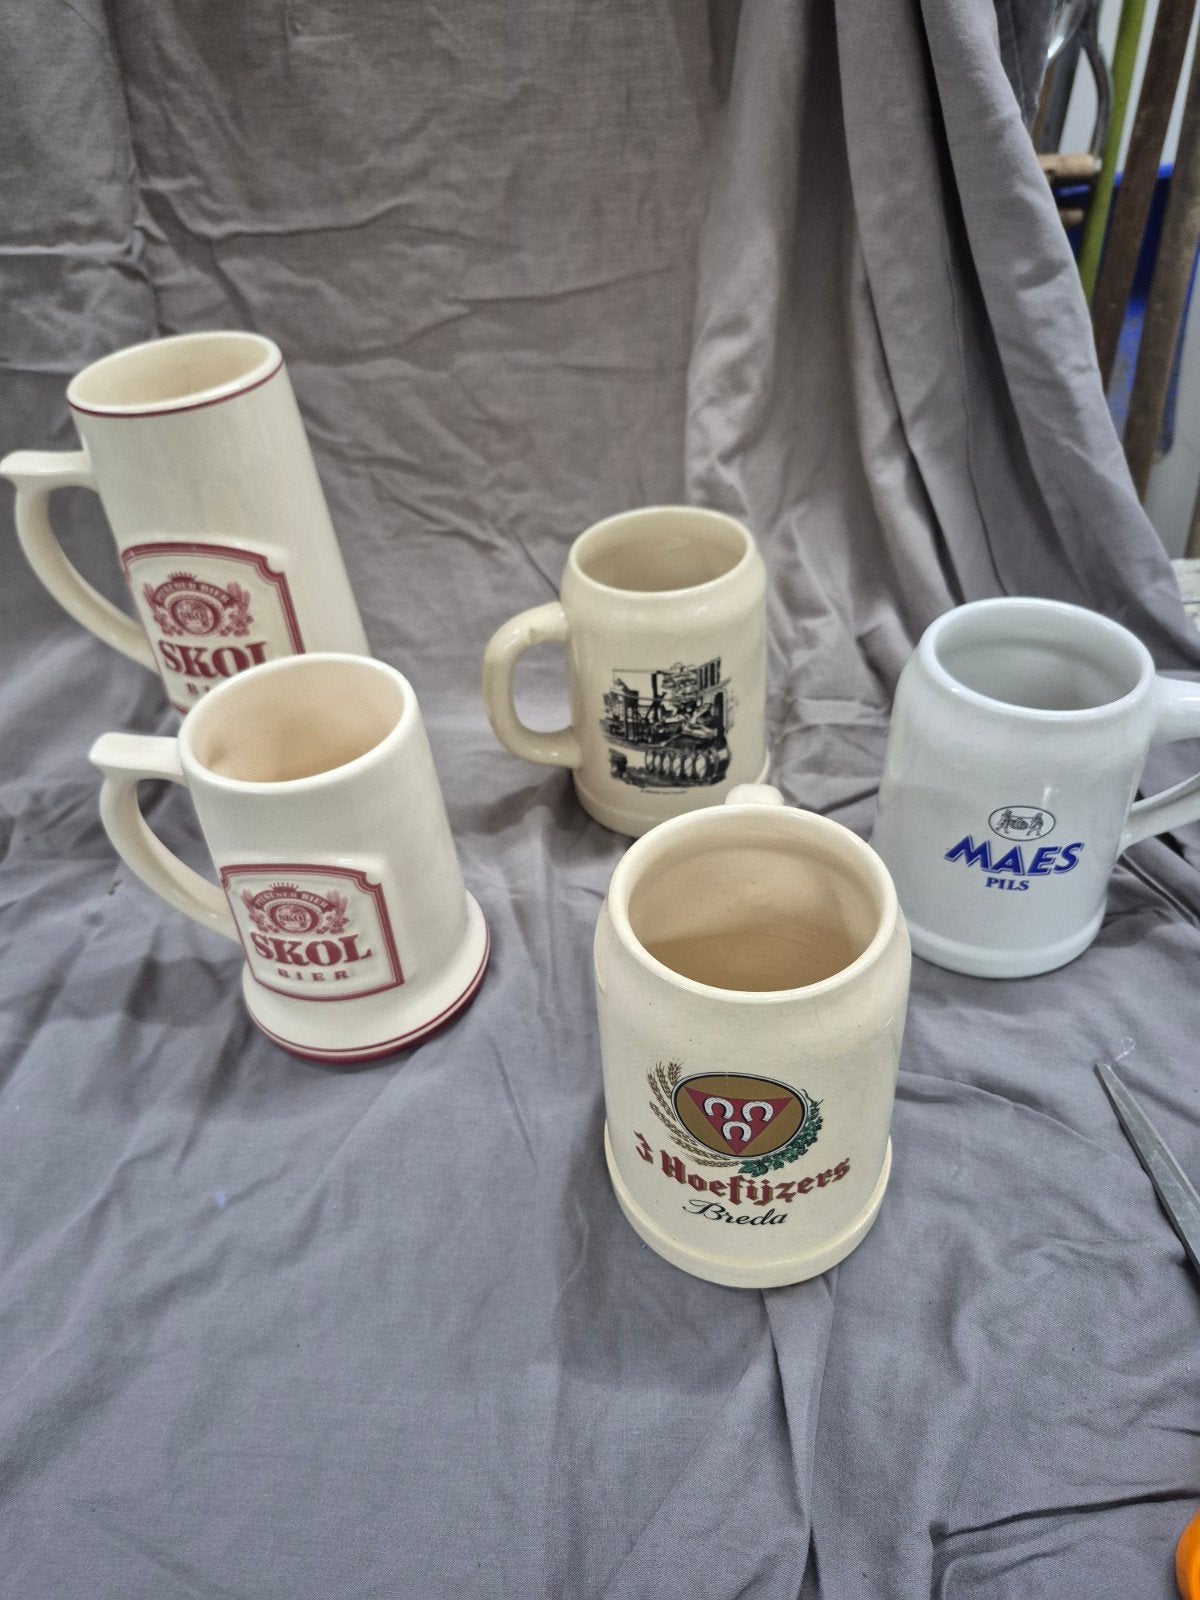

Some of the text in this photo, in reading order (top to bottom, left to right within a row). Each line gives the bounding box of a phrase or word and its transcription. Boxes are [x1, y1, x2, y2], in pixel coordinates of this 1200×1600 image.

[944, 835, 1084, 876] MAES
[985, 877, 1030, 891] PILS
[301, 894, 328, 908] BIER
[250, 933, 373, 966] SKOL
[278, 968, 348, 981] BIER
[633, 1130, 851, 1206] 3 Hoefijzers
[682, 1199, 789, 1226] Breda
